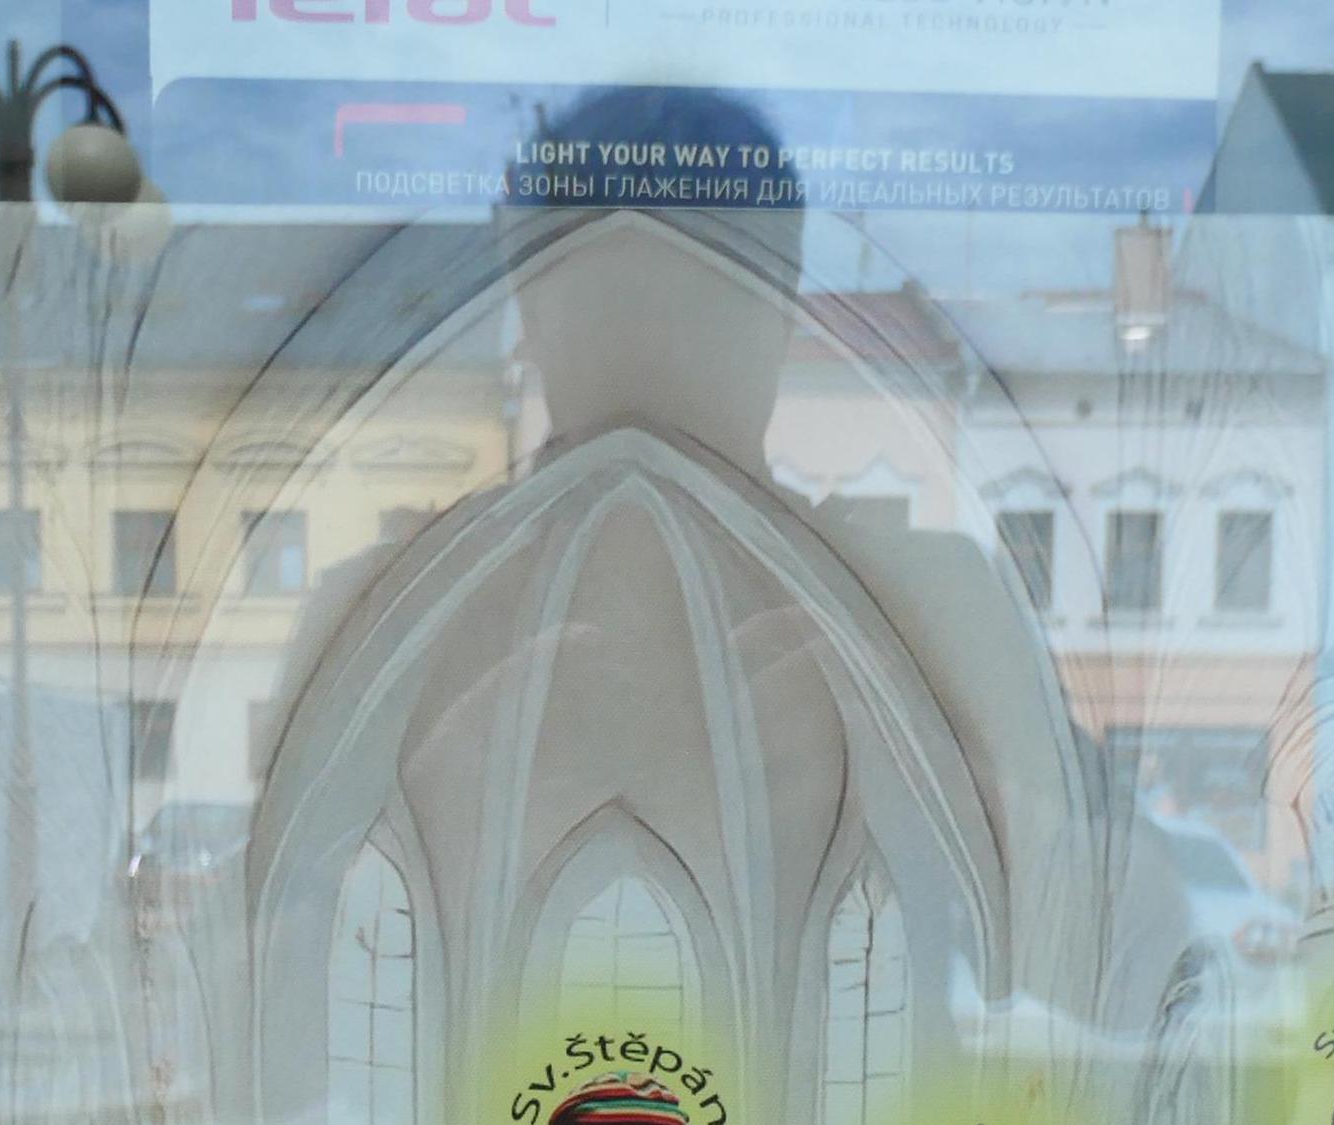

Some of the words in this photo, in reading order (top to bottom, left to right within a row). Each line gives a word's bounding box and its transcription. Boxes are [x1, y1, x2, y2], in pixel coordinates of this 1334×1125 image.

[516, 141, 591, 165] LIGHT
[598, 143, 665, 167] YOUR
[675, 145, 730, 168] WAY
[738, 146, 769, 168] TO
[778, 146, 892, 172] PERFECT
[900, 149, 1015, 175] RESULTS
[356, 170, 510, 198] ПОДСВЕТКА
[518, 173, 595, 198] ЗОНЫ
[604, 176, 748, 200] ГЛАЖЕНИЯ
[757, 179, 807, 204] ДЛЯ
[819, 181, 983, 208] ИДЕАЛЬНЫХ
[992, 185, 1169, 211] РЕЗУЛЬТАТОВ
